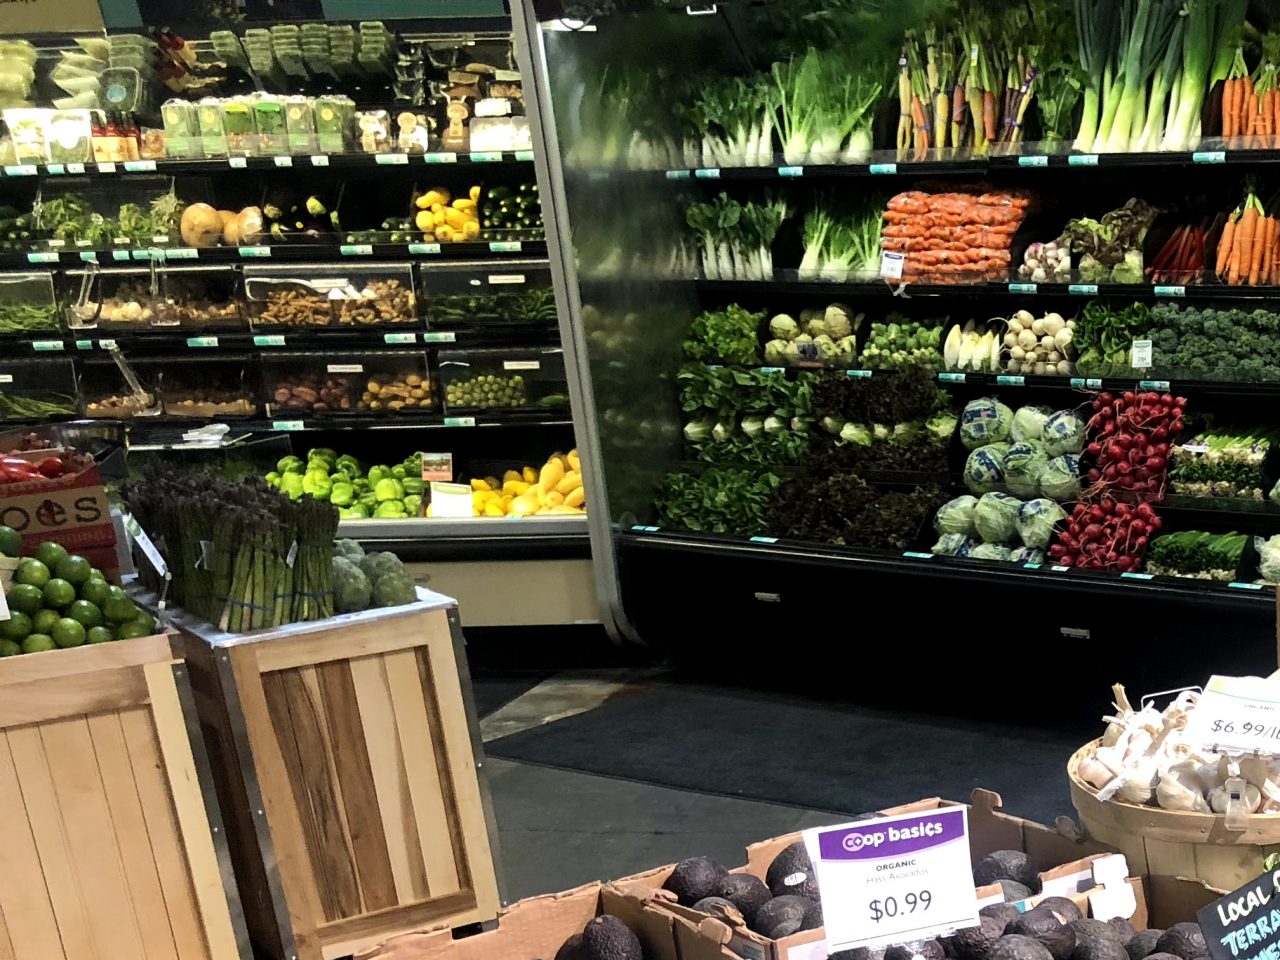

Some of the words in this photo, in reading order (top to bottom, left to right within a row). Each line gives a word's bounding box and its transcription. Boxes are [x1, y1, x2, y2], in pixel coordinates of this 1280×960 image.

[876, 858, 917, 872] ORGANIC
[869, 889, 933, 924] $0.99
[1216, 885, 1272, 927] LOCAL
